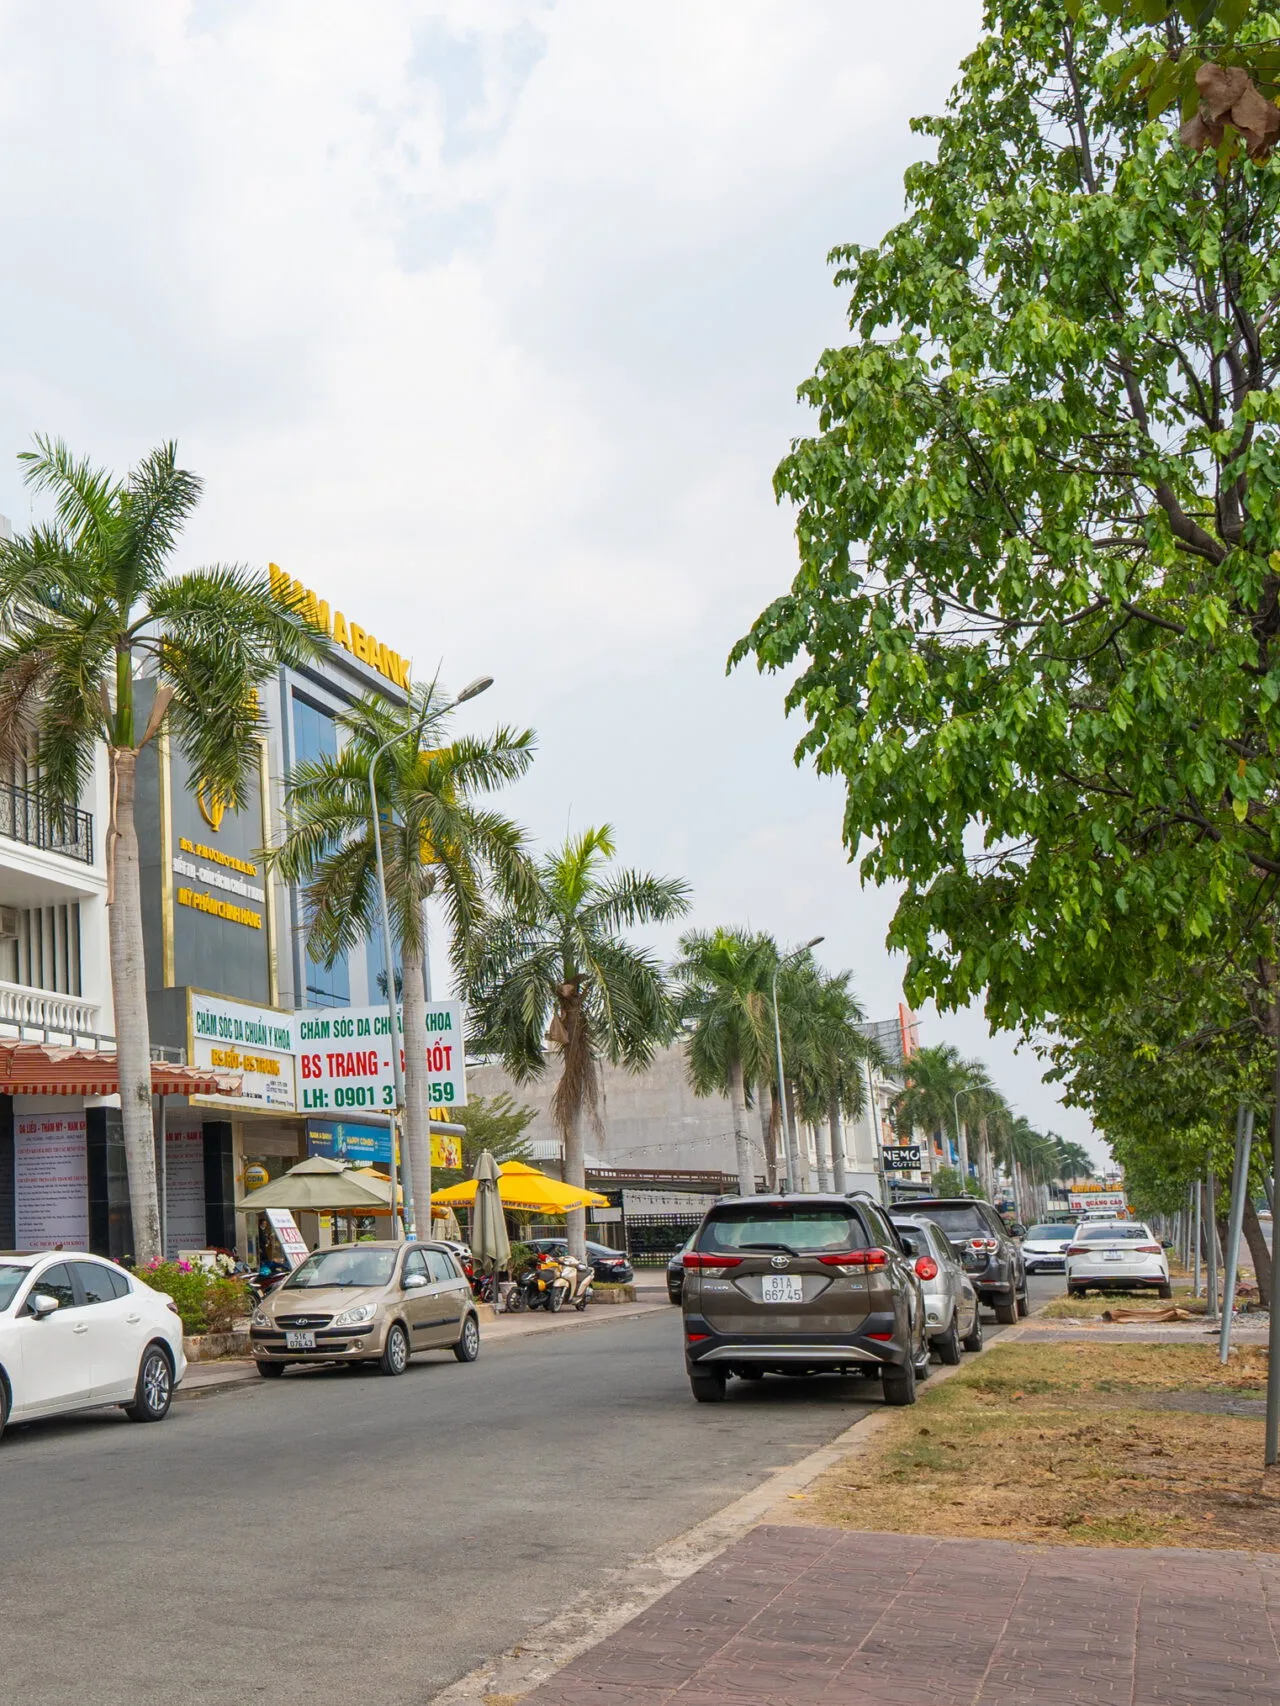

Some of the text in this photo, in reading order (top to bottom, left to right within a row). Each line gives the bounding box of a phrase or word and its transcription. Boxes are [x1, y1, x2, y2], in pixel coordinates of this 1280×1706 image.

[333, 611, 411, 694] A BANK
[196, 1008, 217, 1036] CHĂM
[218, 1012, 233, 1039] SÓC
[234, 1018, 244, 1041] DA
[244, 1015, 267, 1045] CHUẨN
[274, 1026, 291, 1050] KHOA
[300, 1018, 330, 1040] CHĂM
[333, 1016, 354, 1039] SÓC
[357, 1018, 371, 1037] DA
[301, 1050, 378, 1079] BS TRANG
[303, 1088, 328, 1109] LH:
[335, 1086, 374, 1107] 0901
[883, 1150, 920, 1161] NEMO
[765, 1289, 801, 1301] 667.45
[772, 1278, 792, 1289] 61A
